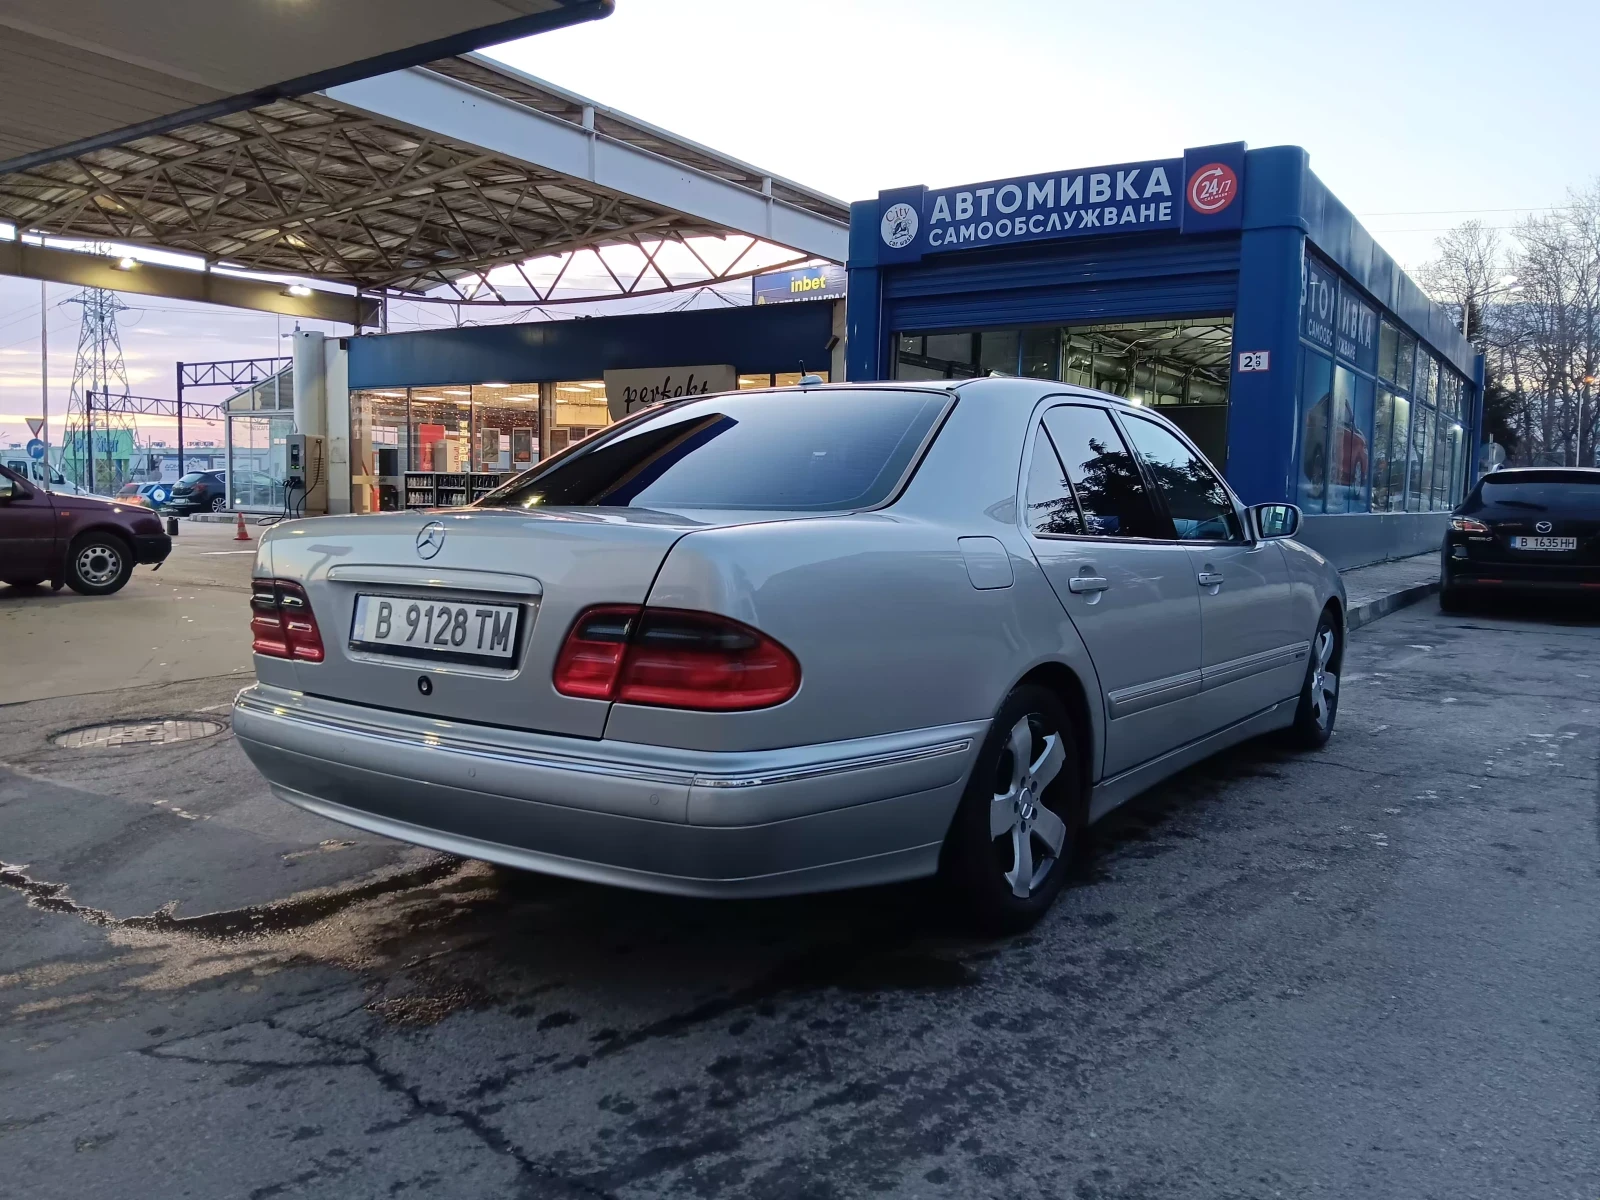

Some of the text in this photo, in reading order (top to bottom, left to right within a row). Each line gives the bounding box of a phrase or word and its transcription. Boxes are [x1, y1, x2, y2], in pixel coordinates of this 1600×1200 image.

[929, 167, 1172, 224] АВТОМИВКА
[1200, 178, 1231, 198] 24/7
[886, 206, 910, 222] City
[929, 202, 1172, 246] САМООБСЛУЖВАНЕ
[790, 275, 826, 293] inbet
[1521, 537, 1575, 548] B 1635 HH
[375, 602, 513, 652] B 9128 TM
